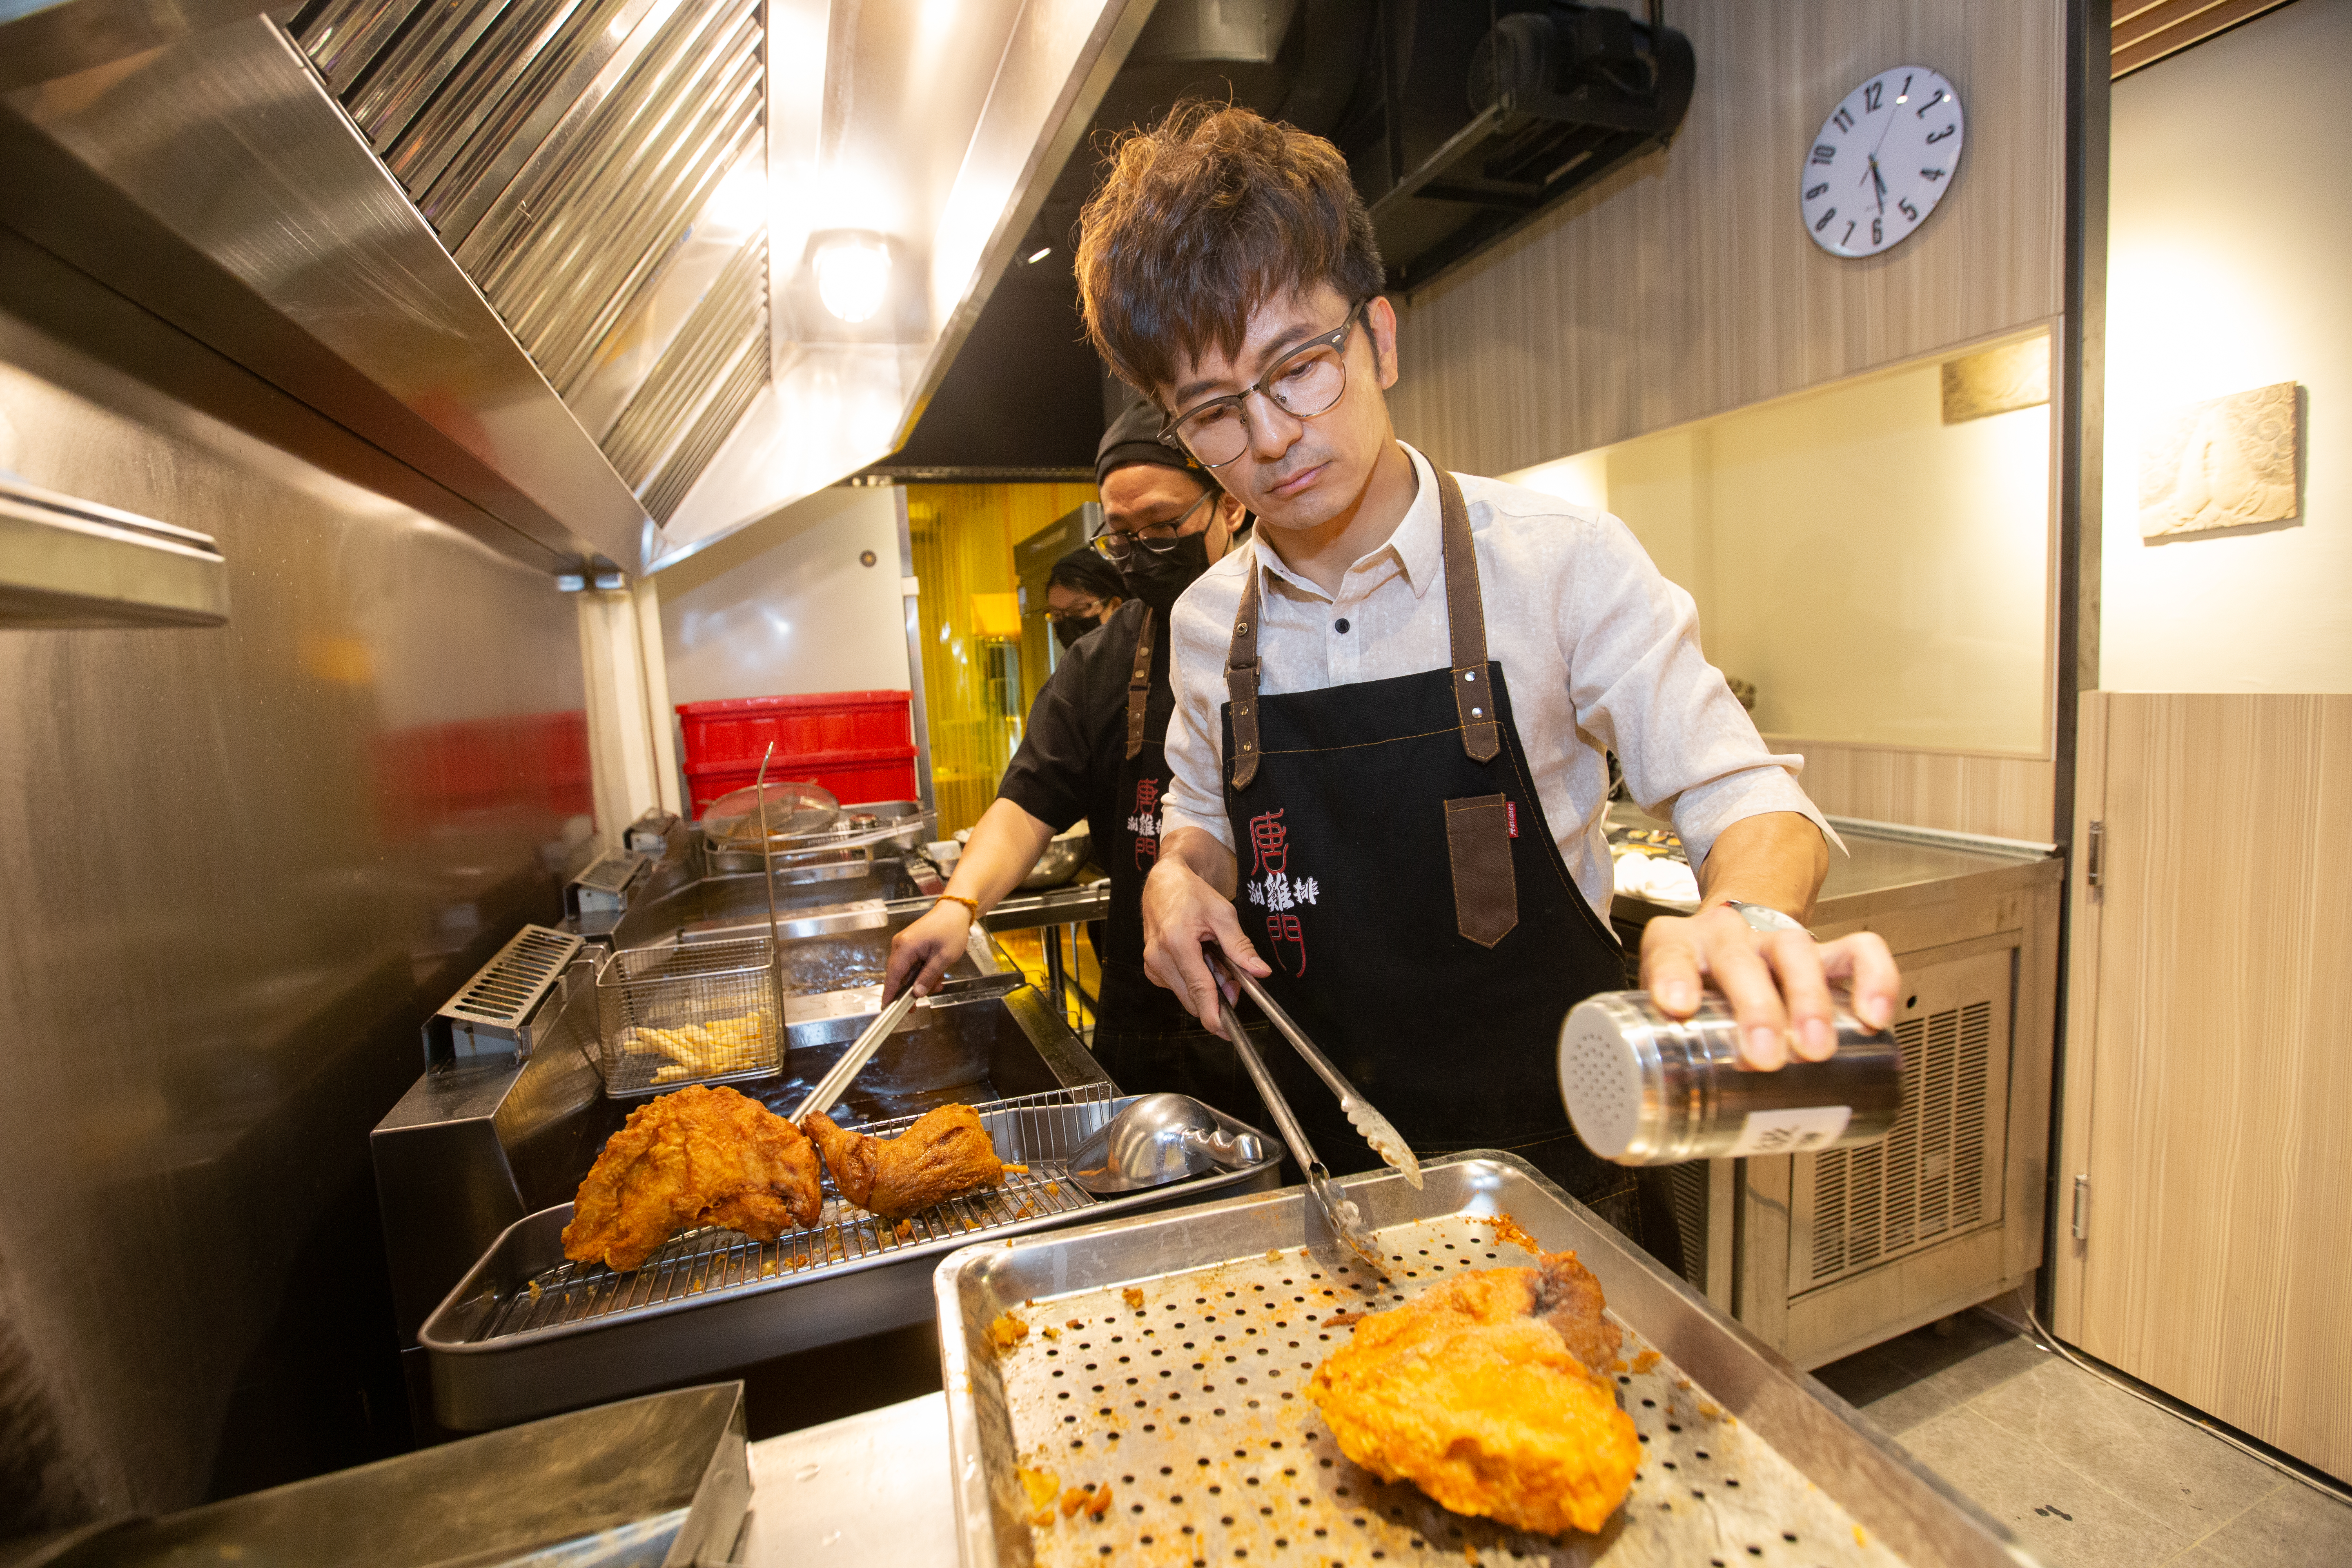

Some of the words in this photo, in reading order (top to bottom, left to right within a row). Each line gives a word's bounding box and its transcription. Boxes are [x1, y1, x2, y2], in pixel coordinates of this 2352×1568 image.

[1864, 81, 1883, 114] 12
[1901, 74, 1913, 96] 1
[1916, 88, 1945, 119] 2
[1832, 106, 1855, 134] 11
[1925, 123, 1956, 145] 3
[1811, 144, 1837, 165] 10
[1919, 168, 1946, 182] 4
[1804, 182, 1829, 201] 9
[1814, 207, 1837, 233] 8
[1898, 197, 1918, 222] 5
[1841, 220, 1857, 247] 7
[1871, 217, 1883, 246] 6
[1250, 807, 1289, 876] 唐
[1265, 913, 1307, 978] 門
